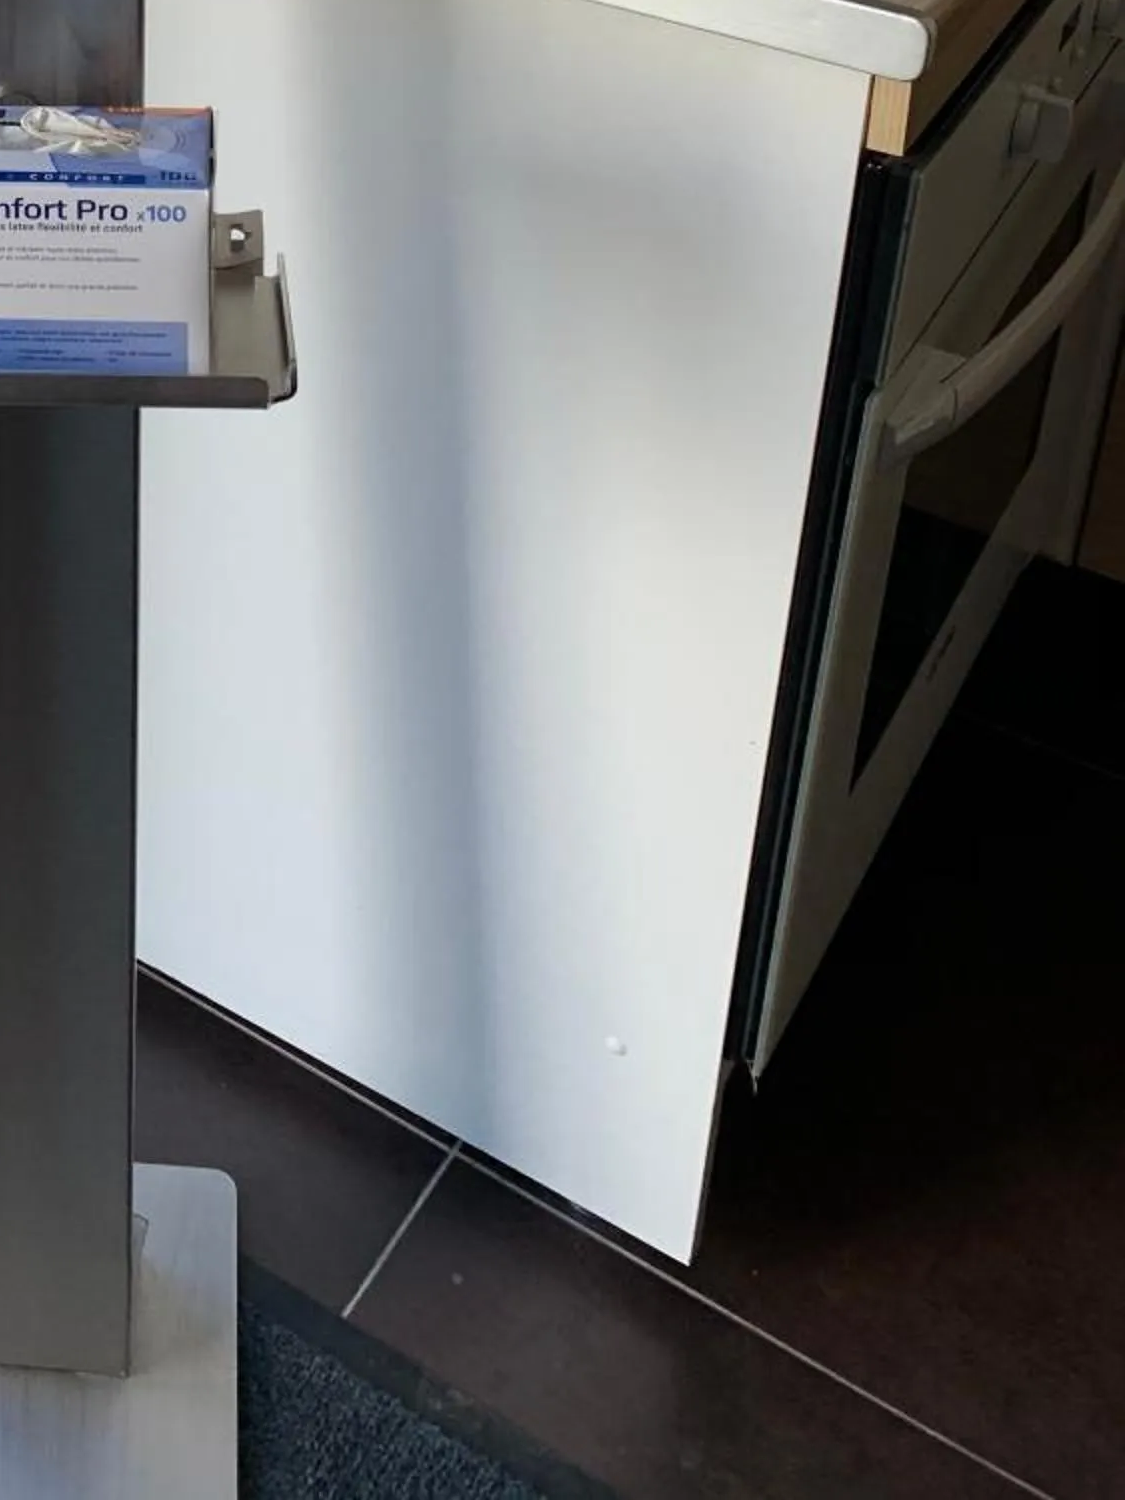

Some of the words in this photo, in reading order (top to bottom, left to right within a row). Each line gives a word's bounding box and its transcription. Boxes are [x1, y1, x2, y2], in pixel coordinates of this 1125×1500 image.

[76, 198, 128, 221] Pro
[136, 203, 187, 223] x100
[90, 223, 100, 232] et
[102, 223, 143, 233] confort
